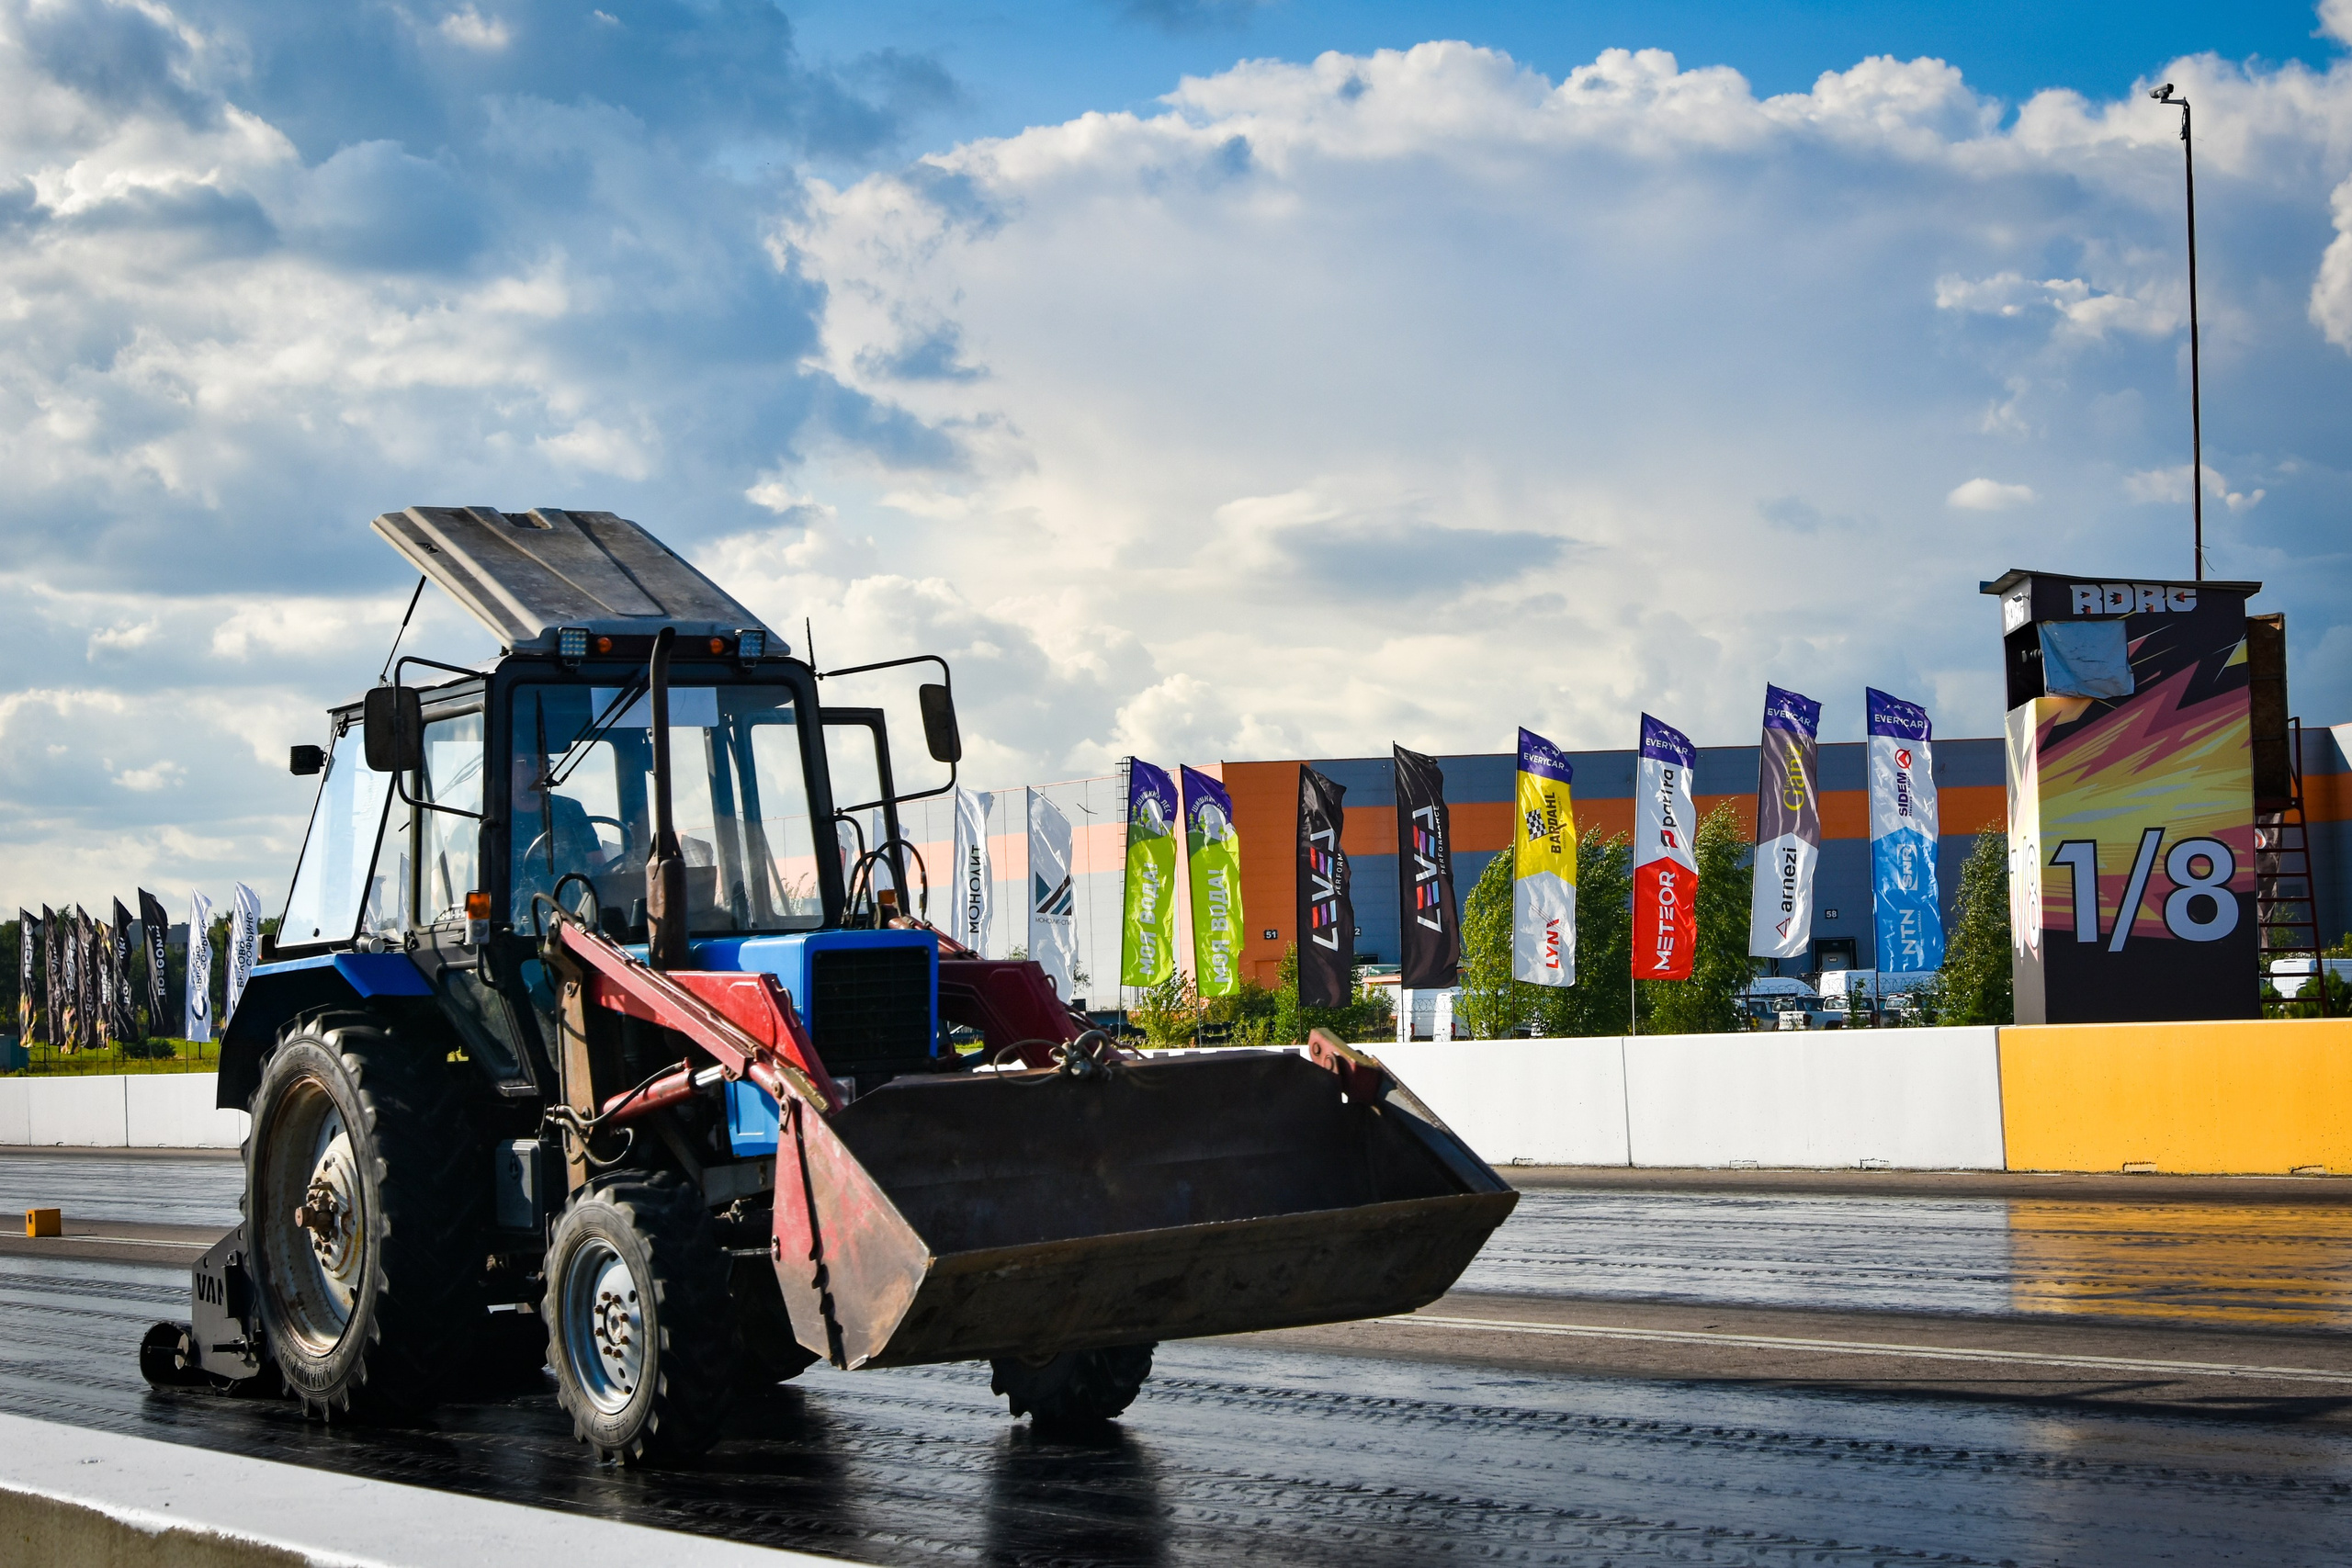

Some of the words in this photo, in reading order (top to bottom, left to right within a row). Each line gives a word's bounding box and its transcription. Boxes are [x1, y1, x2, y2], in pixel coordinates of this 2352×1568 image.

[1523, 752, 1565, 771] EVERYCAR
[1783, 742, 1805, 810] Ganz
[1897, 773, 1909, 817] SIDEM
[1545, 792, 1562, 853] BARDAHL
[968, 844, 981, 933] МОНОЛИТ
[1335, 852, 1344, 896] PERFORM
[1781, 847, 1796, 912] arnezi
[1902, 847, 1913, 887] SNR
[2048, 827, 2239, 953] 1/8
[1140, 863, 1160, 925] ВОДА!
[1208, 869, 1228, 931] ВОДА!
[1826, 909, 1837, 918] 58
[245, 912, 254, 966] СОФЬИНО
[1265, 931, 1276, 939] 51
[1546, 919, 1560, 968] LYNX
[1654, 871, 1676, 971] METEOR
[1899, 909, 1917, 955] NTN
[237, 942, 246, 987] БЫКОВО
[1139, 931, 1156, 976] МОЯ
[1212, 940, 1230, 984] МОЯ
